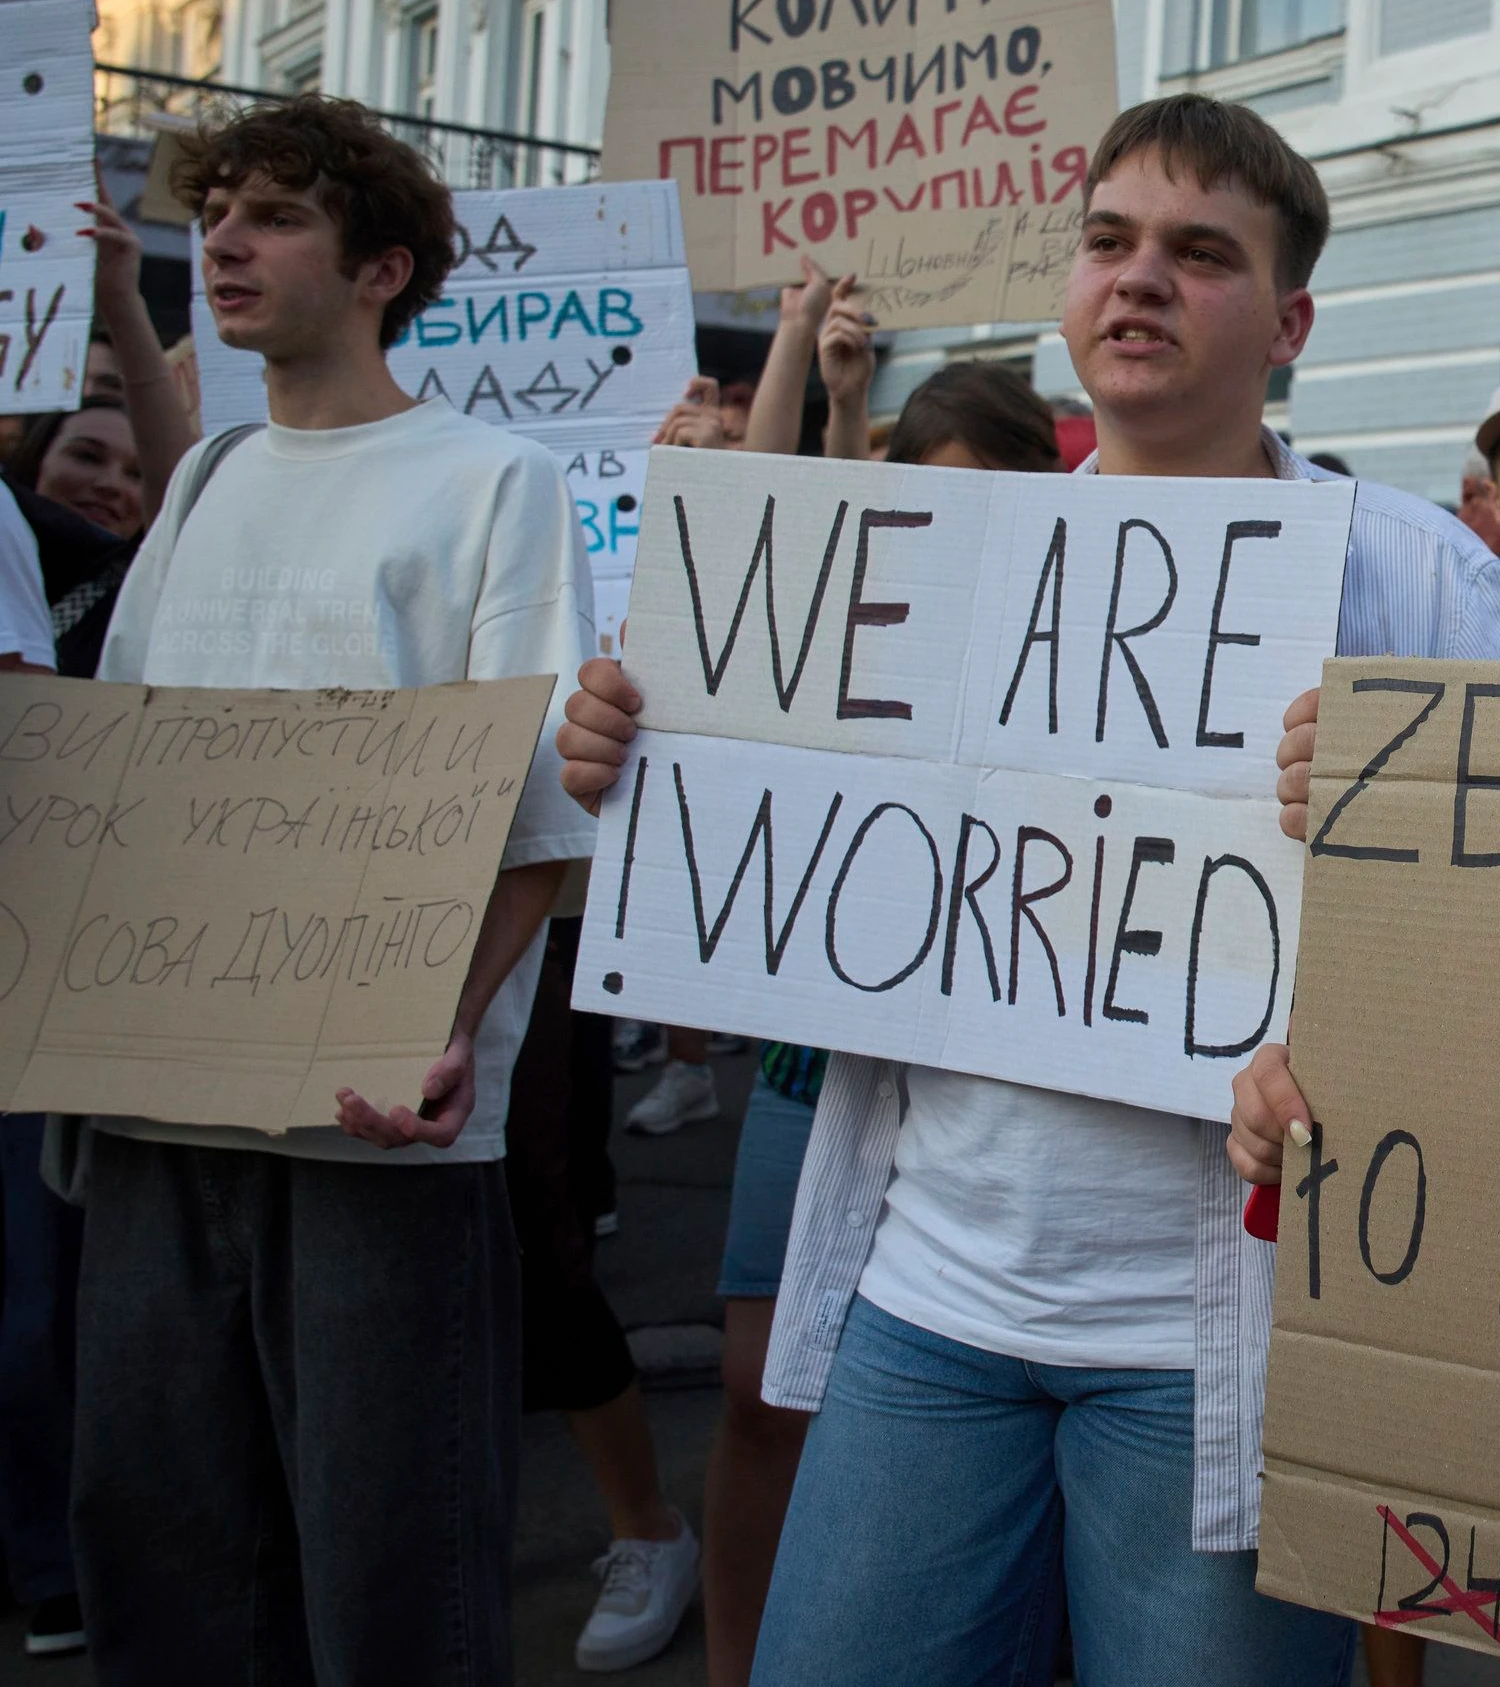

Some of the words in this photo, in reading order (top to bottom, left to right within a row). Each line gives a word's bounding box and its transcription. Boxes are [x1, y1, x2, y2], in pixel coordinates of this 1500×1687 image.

[712, 26, 1052, 125] МОВЧИМО,
[660, 85, 1047, 196] ПЕРЕМАГАЄ
[762, 143, 1088, 256] КОРУПЦІЯ
[391, 288, 644, 348] БИРАВ
[221, 567, 338, 592] BUILDING
[260, 632, 303, 655] THE
[673, 494, 933, 721] WE
[998, 516, 1282, 750] ARE
[137, 716, 494, 778] ПРОПУСТИЛИ
[0, 795, 147, 849] УРОК
[64, 912, 209, 993] СОВА
